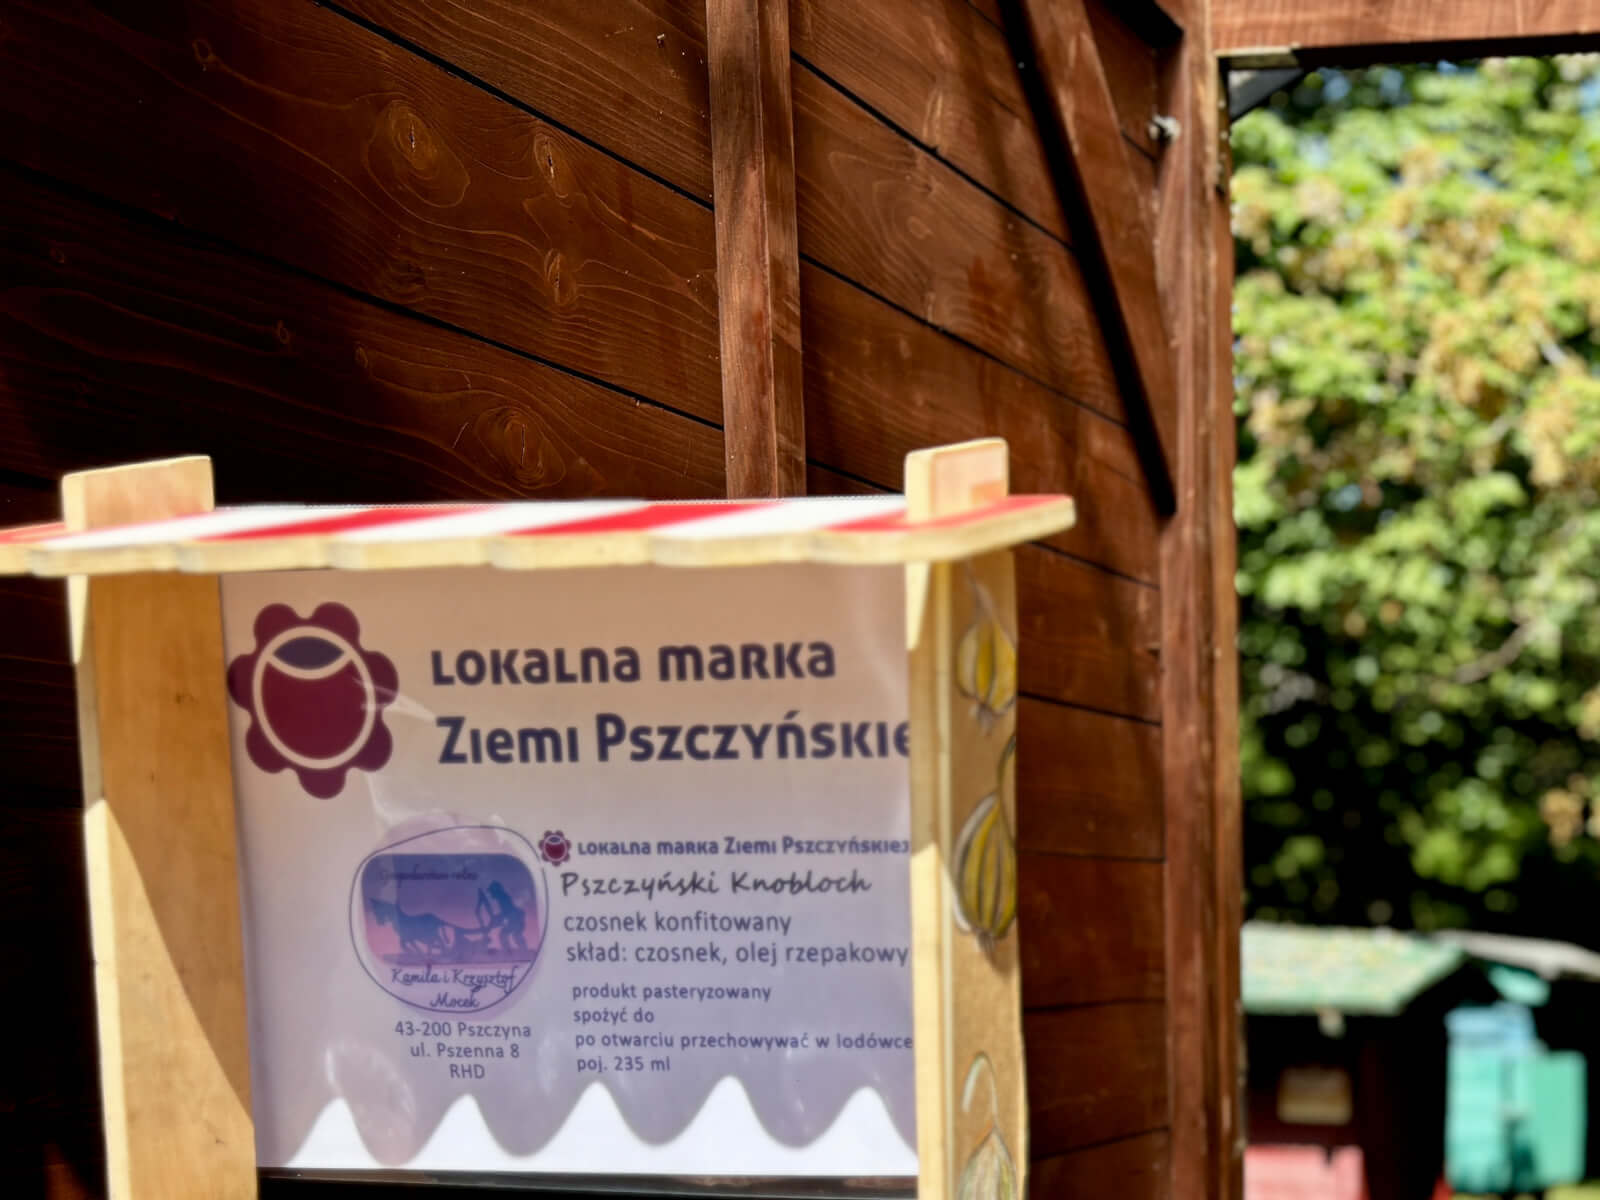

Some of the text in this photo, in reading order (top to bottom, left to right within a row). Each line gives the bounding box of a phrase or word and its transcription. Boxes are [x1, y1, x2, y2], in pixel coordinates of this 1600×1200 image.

[595, 710, 911, 764] Pszczyńskie
[560, 868, 873, 901] Pszczyński Knobloch
[564, 910, 792, 936] czosnek konfitowany
[567, 942, 909, 967] skład: czosnek, olej rzepakowy
[572, 984, 772, 1002] produkt pasteryzowany
[573, 1008, 655, 1026] spożyć do
[394, 1021, 531, 1040] 43-200 Pszczyna
[410, 1042, 521, 1059] ul. Pszenna 8
[575, 1032, 912, 1051] po otwarciu przechowywać w lodówce
[449, 1064, 486, 1080] RHD
[577, 1057, 671, 1072] poj. 235 ml
